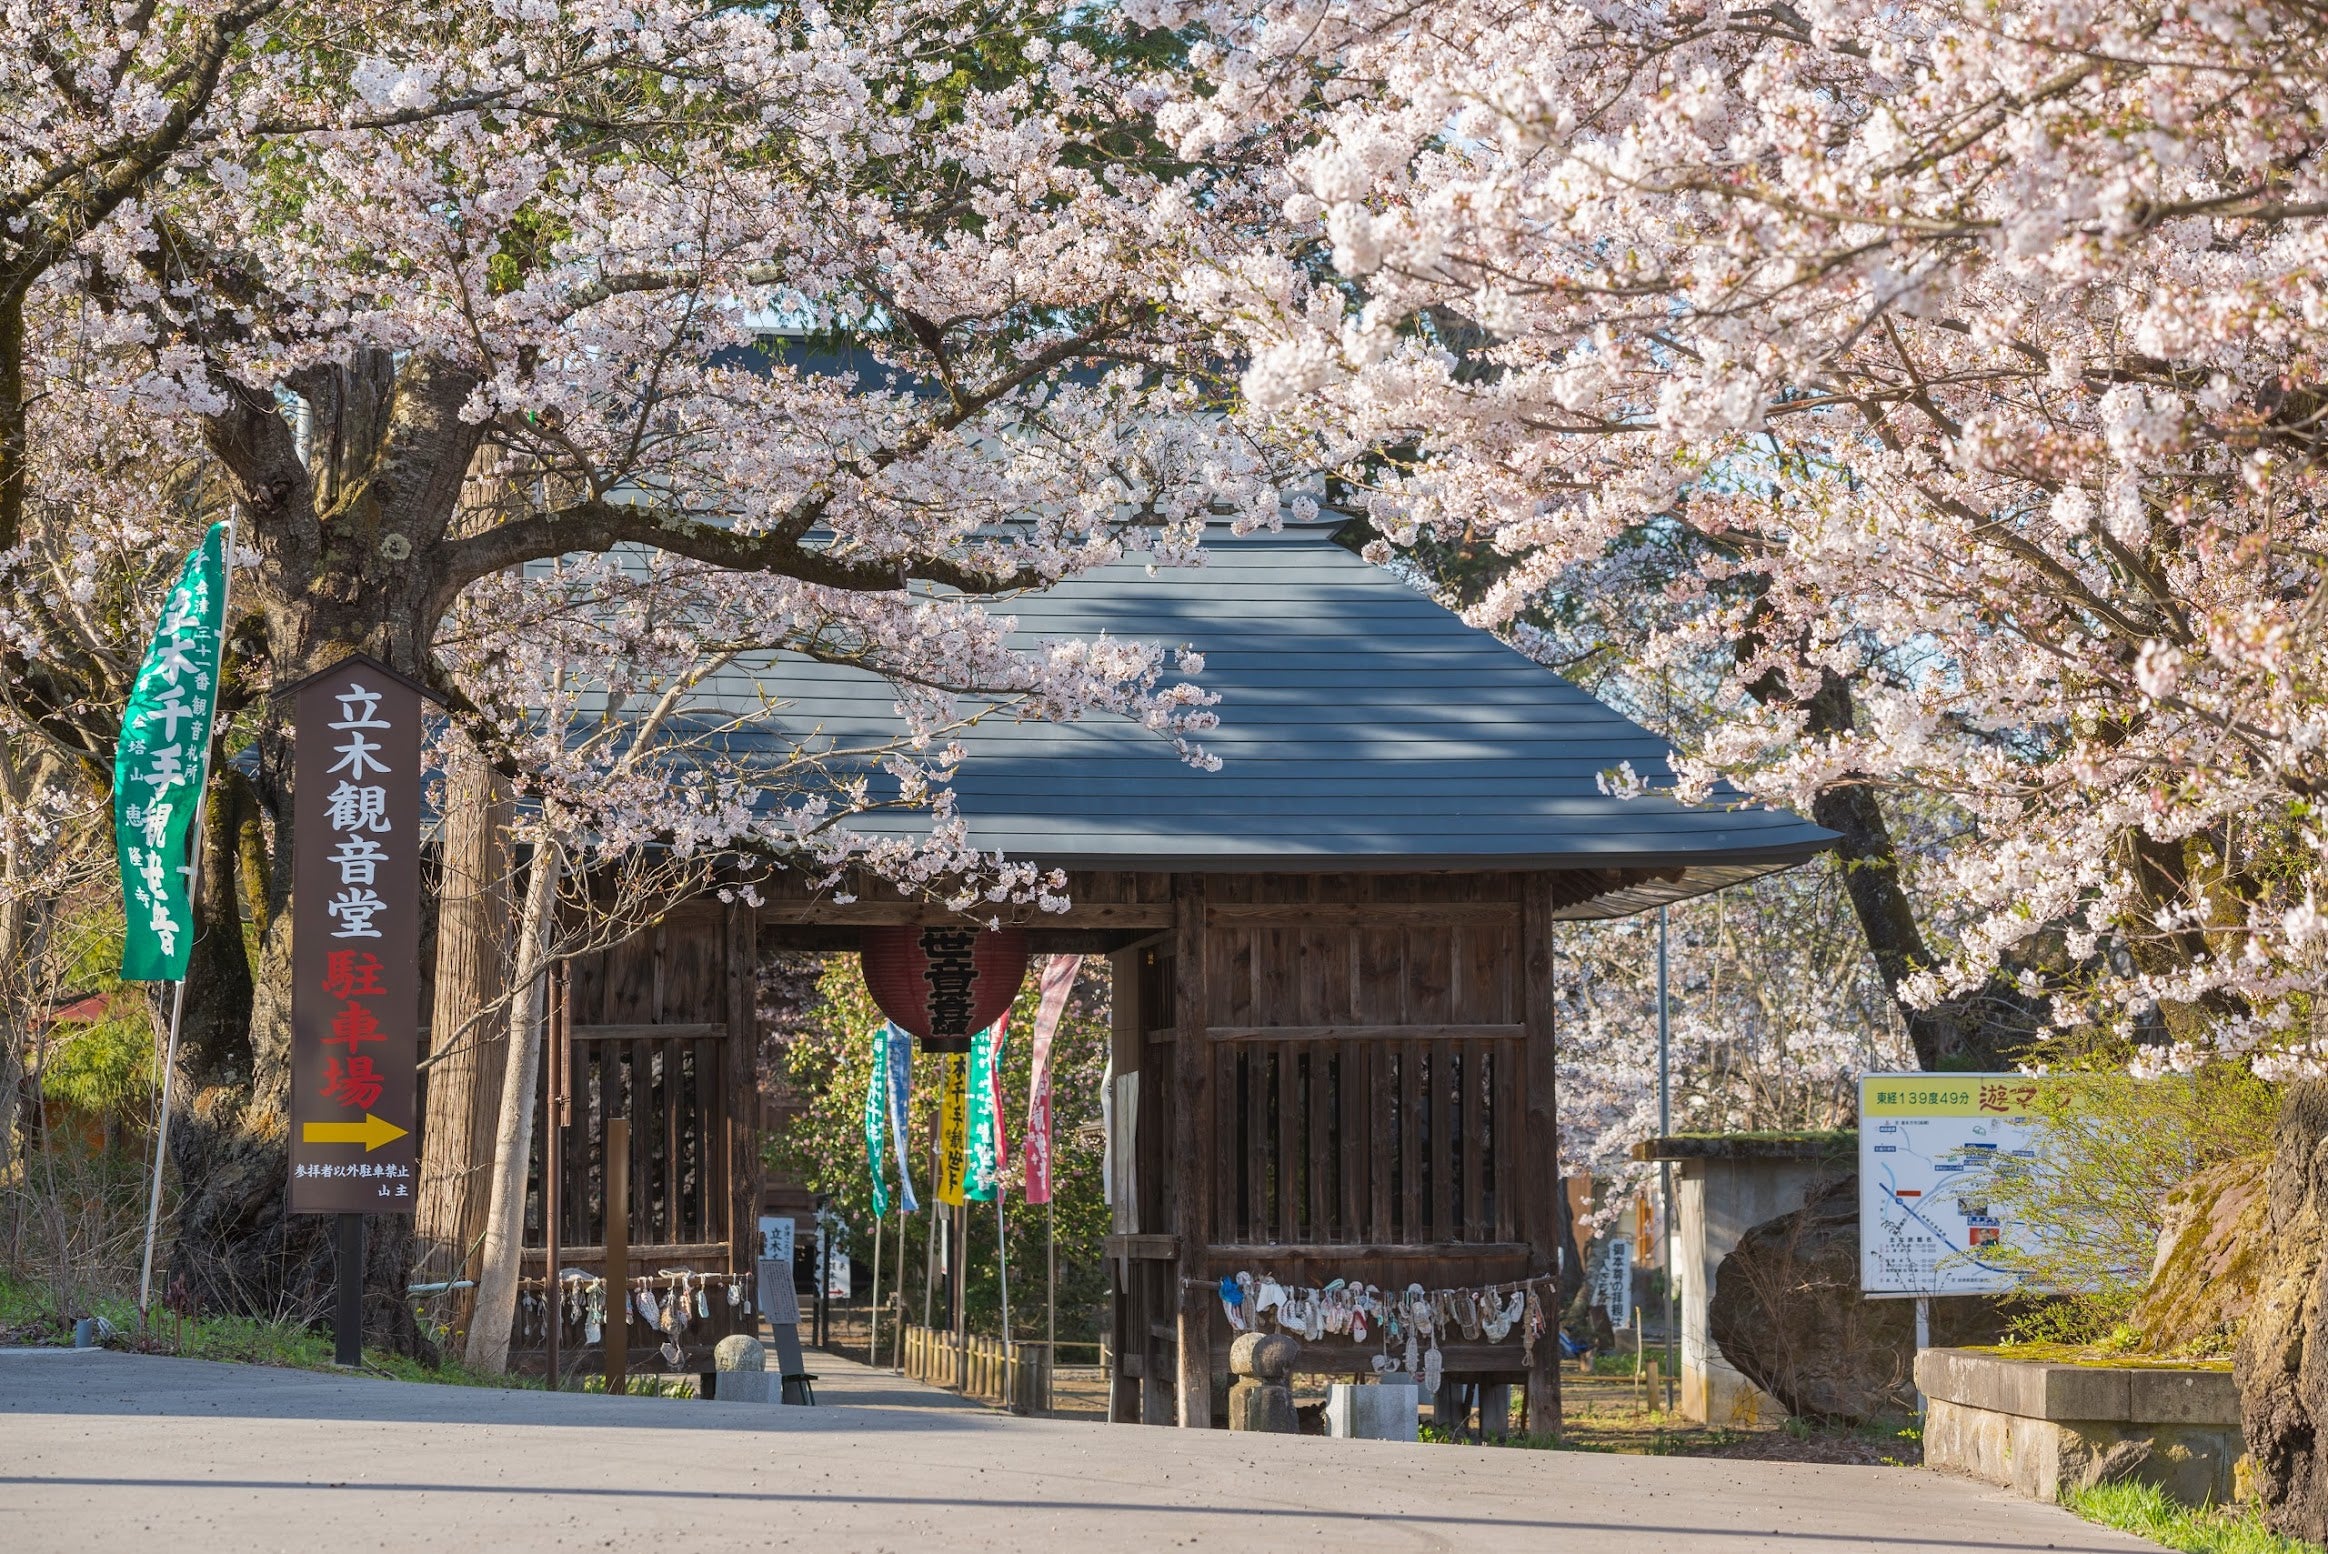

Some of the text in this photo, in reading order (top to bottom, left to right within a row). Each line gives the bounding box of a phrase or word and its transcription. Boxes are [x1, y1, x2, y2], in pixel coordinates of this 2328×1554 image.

[323, 683, 392, 939] 立木観音堂
[918, 926, 980, 1035] 世音菩薩
[320, 949, 389, 1111] 駐車場
[1876, 1092, 1969, 1106] 東経139度49分
[294, 1163, 410, 1179] 参拝者以外駐車禁止
[378, 1184, 409, 1197] 山主
